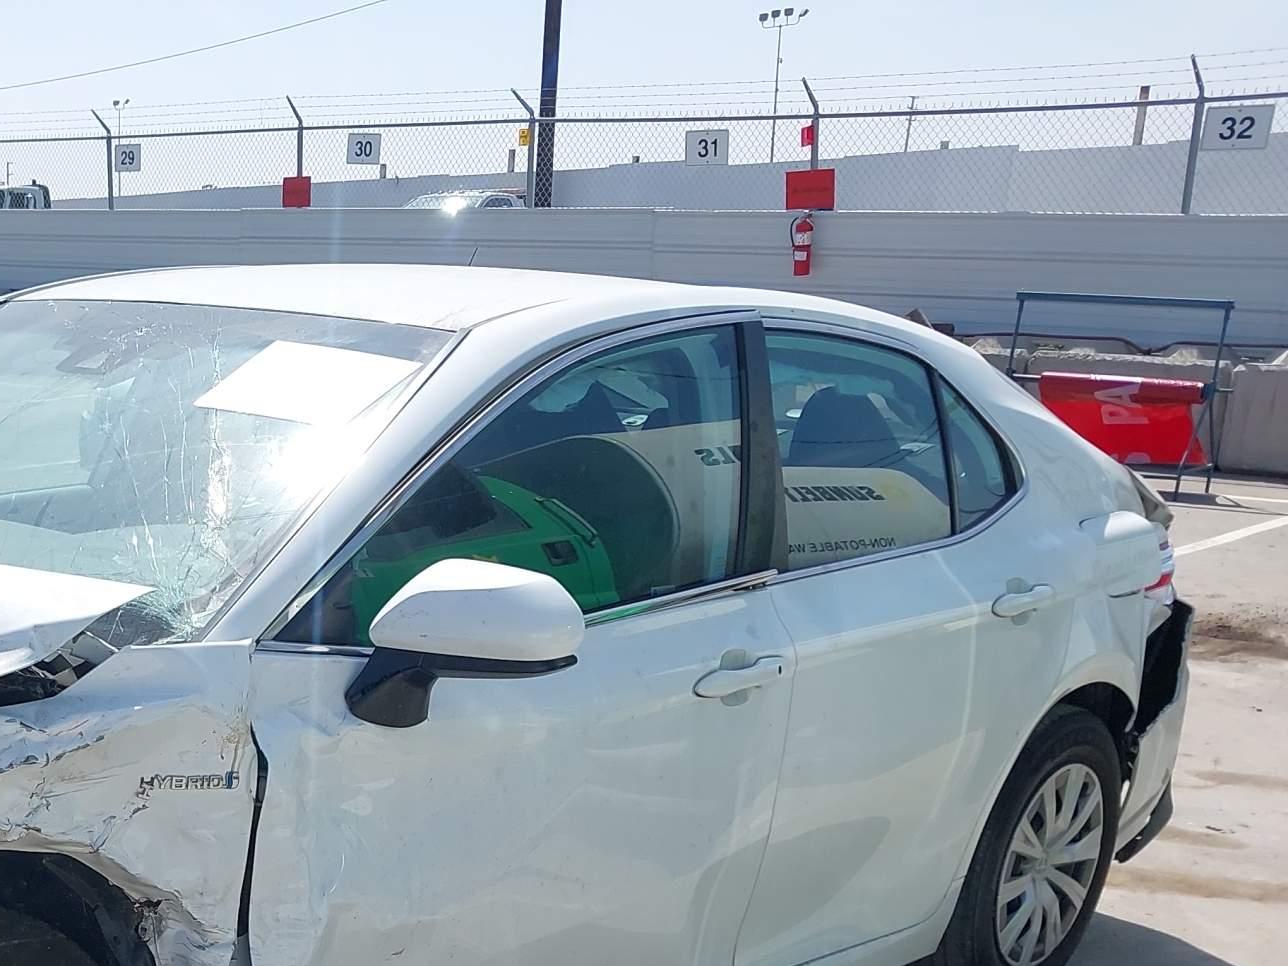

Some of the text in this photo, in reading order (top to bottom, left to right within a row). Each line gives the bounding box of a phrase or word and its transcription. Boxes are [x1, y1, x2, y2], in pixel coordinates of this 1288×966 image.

[1218, 115, 1256, 141] 32
[120, 150, 135, 166] 29
[354, 140, 373, 157] 30
[697, 138, 719, 158] 31
[136, 774, 223, 801] HYBRID
